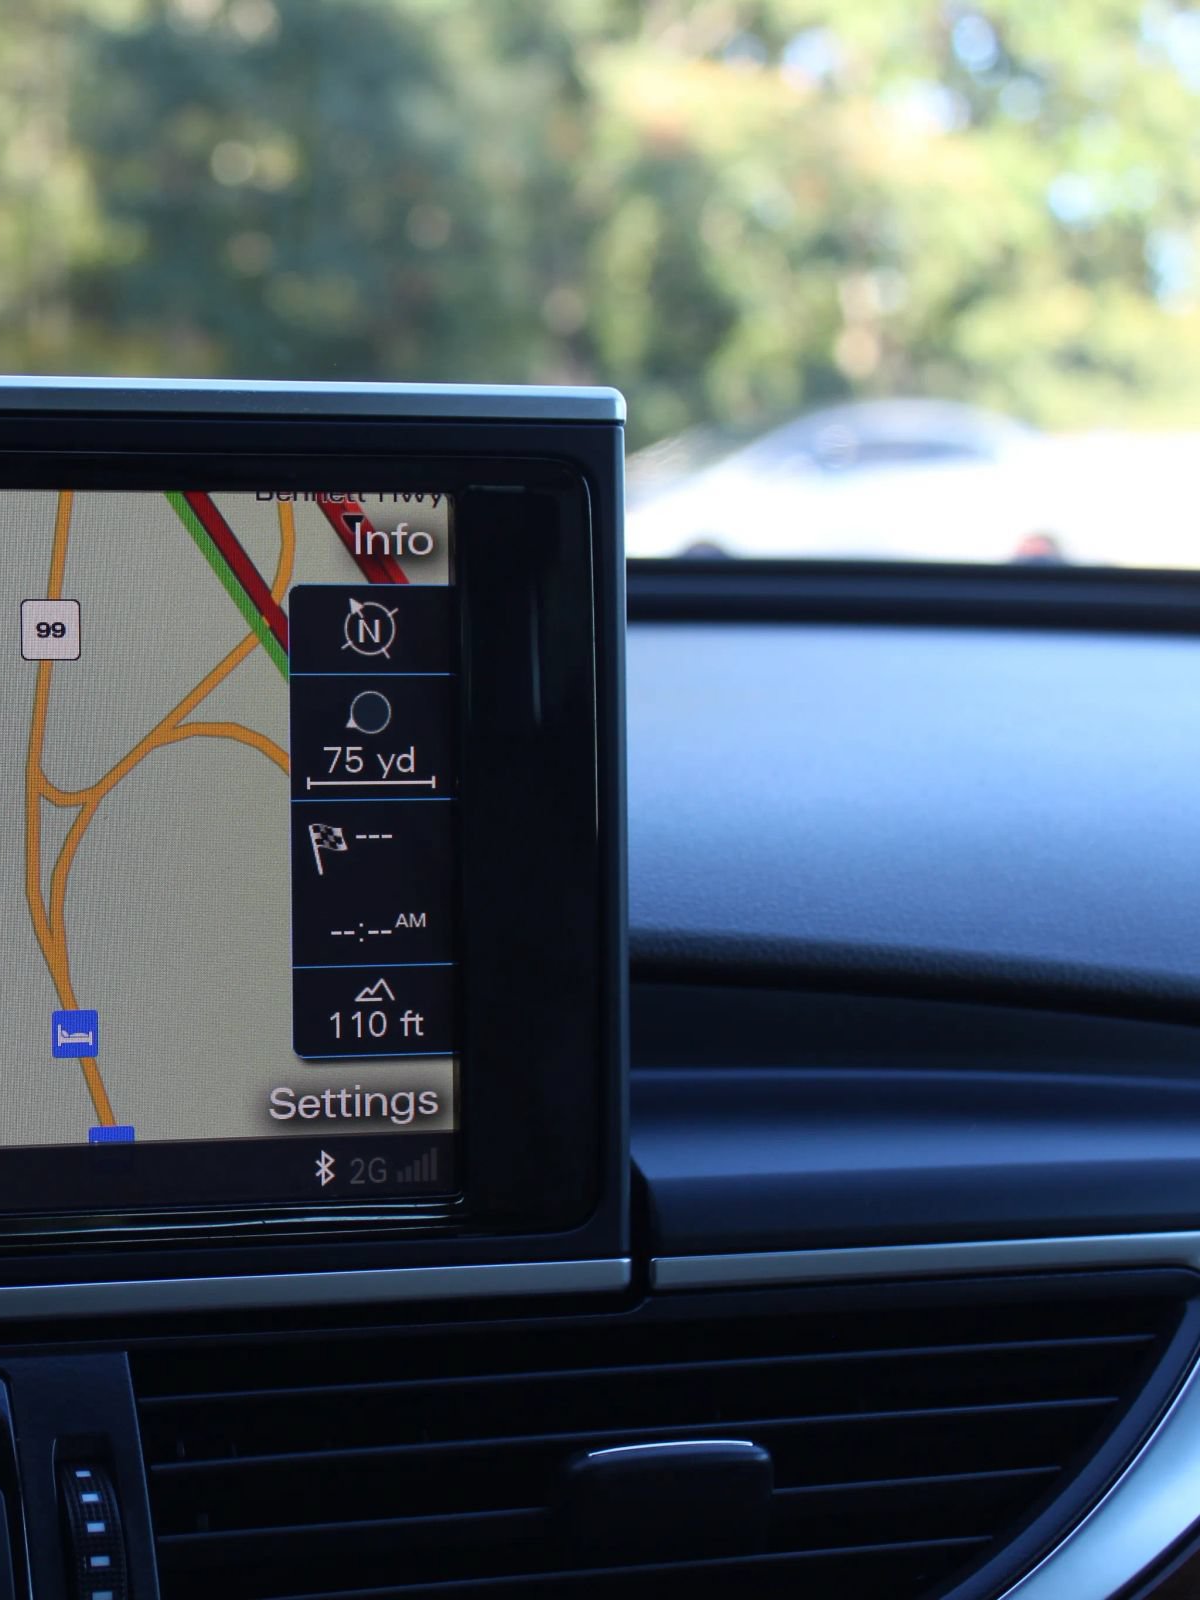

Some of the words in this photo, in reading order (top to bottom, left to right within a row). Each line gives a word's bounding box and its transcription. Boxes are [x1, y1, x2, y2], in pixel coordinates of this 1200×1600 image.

[354, 521, 434, 556] Info
[35, 620, 67, 639] 99
[358, 619, 380, 644] N
[323, 746, 363, 773] 75
[377, 746, 416, 779] yd
[329, 1010, 388, 1039] 110
[400, 1009, 424, 1037] ft
[269, 1084, 439, 1125] Settings
[350, 1157, 388, 1185] 2G
